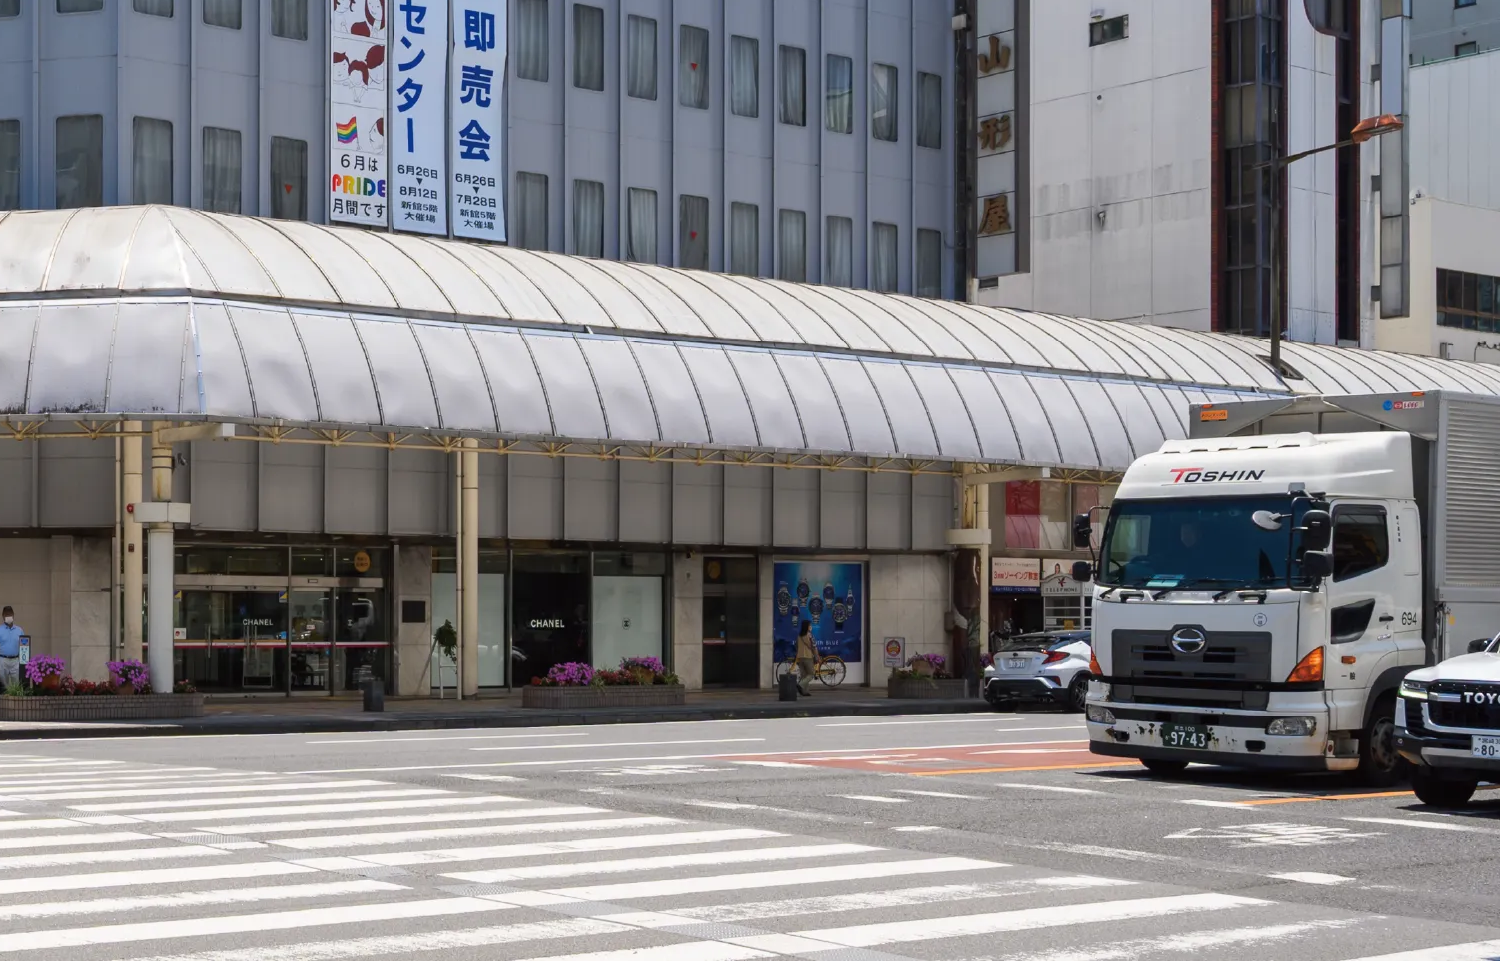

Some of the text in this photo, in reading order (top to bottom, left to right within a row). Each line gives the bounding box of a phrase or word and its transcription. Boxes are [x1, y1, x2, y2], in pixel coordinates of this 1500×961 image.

[977, 34, 1011, 236] 山形屋
[340, 154, 378, 172] 6月は
[397, 164, 438, 180] 6月26日
[332, 174, 386, 198] PRIDE
[456, 173, 496, 188] 6月26日
[399, 186, 438, 200] 8月12日
[332, 198, 386, 218] 月間です
[456, 194, 496, 208] 7月28日
[404, 212, 436, 224] 大催場
[463, 220, 494, 230] 大催場
[1170, 468, 1265, 483] TOSHIN
[530, 619, 564, 628] CHANEL
[1402, 612, 1417, 625] 694
[1171, 732, 1205, 747] 97-43
